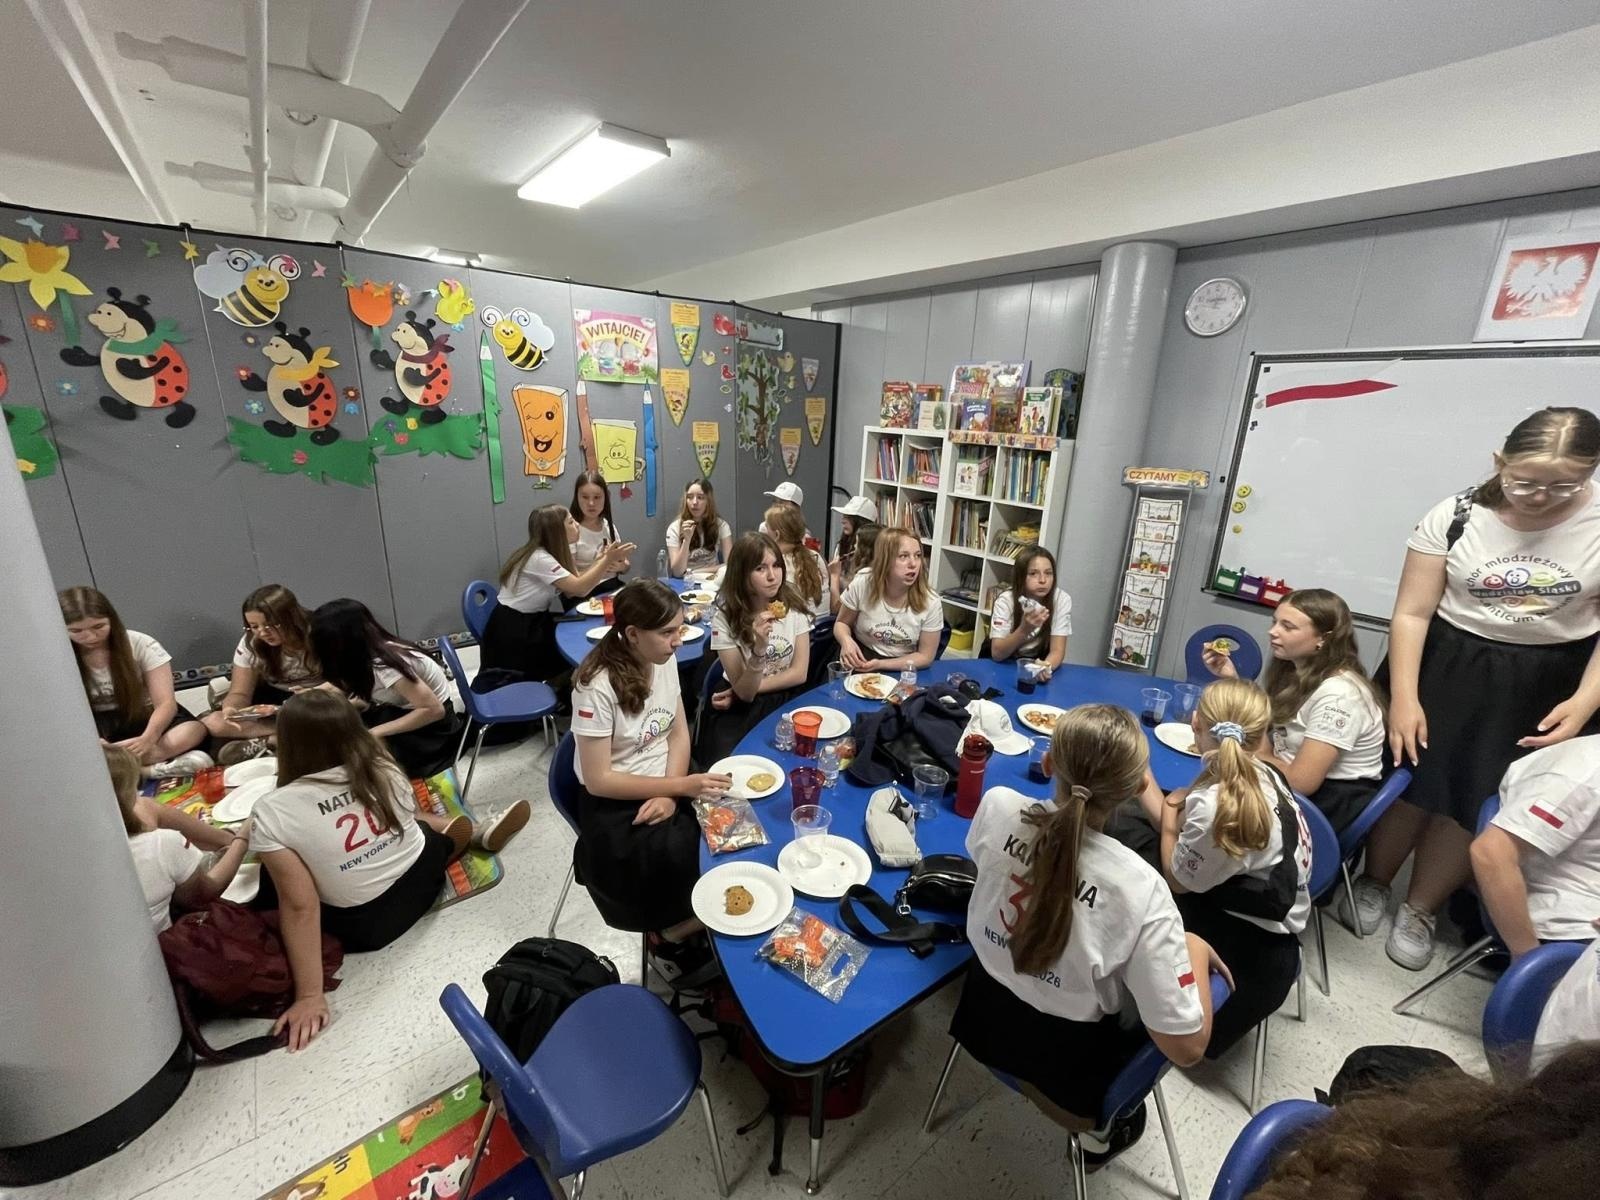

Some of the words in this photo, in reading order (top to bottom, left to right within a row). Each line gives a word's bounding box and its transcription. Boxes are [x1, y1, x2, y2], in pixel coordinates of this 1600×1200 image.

[586, 322, 645, 343] WITAJCIE!
[1129, 471, 1177, 481] CZYTAMY
[339, 856, 362, 872] NEW
[363, 841, 388, 859] YORK
